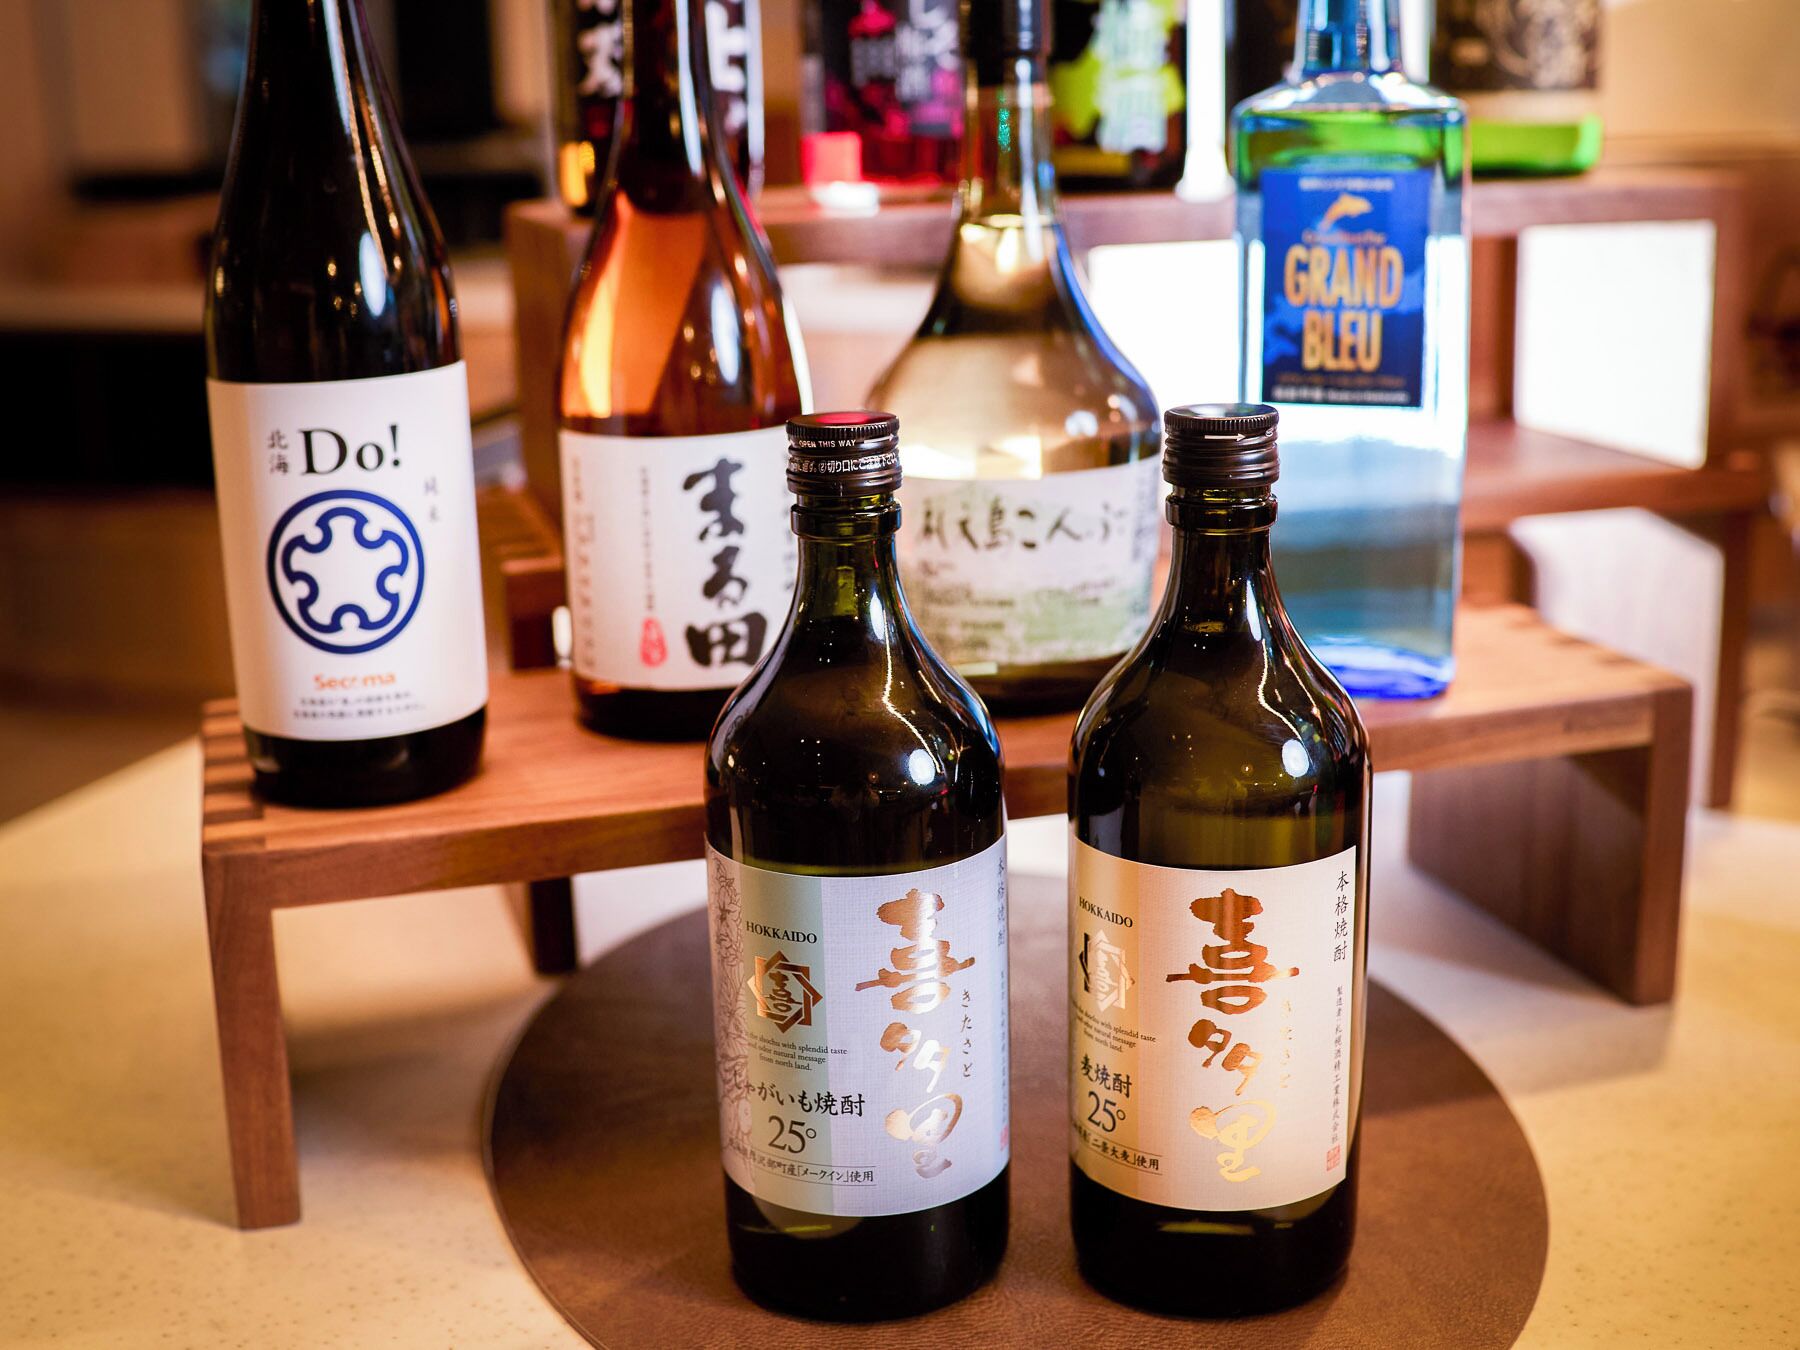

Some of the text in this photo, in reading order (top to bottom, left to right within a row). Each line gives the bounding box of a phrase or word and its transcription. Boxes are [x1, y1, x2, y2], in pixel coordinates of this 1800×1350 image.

[1284, 244, 1404, 308] GRAND
[1303, 310, 1382, 371] BLEU
[267, 429, 289, 475] 北海
[298, 424, 401, 476] Do!
[799, 439, 857, 448] OPEN THIS WAY
[746, 920, 818, 944] HOKKAIDO
[1079, 896, 1133, 928] HOKKAIDO
[1333, 870, 1350, 962] 本格焼酎
[781, 1041, 797, 1050] with
[798, 1045, 828, 1055] splendid
[855, 888, 976, 1179] 喜多里
[960, 988, 974, 1079] きたさと
[1112, 1034, 1136, 1048] message
[1113, 1025, 1139, 1039] splendid
[1140, 1034, 1156, 1043] taste
[1166, 887, 1300, 1183] 喜多里
[773, 1049, 796, 1060] natural
[797, 1054, 826, 1065] message
[774, 1058, 794, 1068] north
[795, 1061, 812, 1071] land.
[1081, 1054, 1132, 1098] 麦焼酎
[1087, 1091, 1126, 1133] 25°
[768, 1115, 817, 1154] 25°
